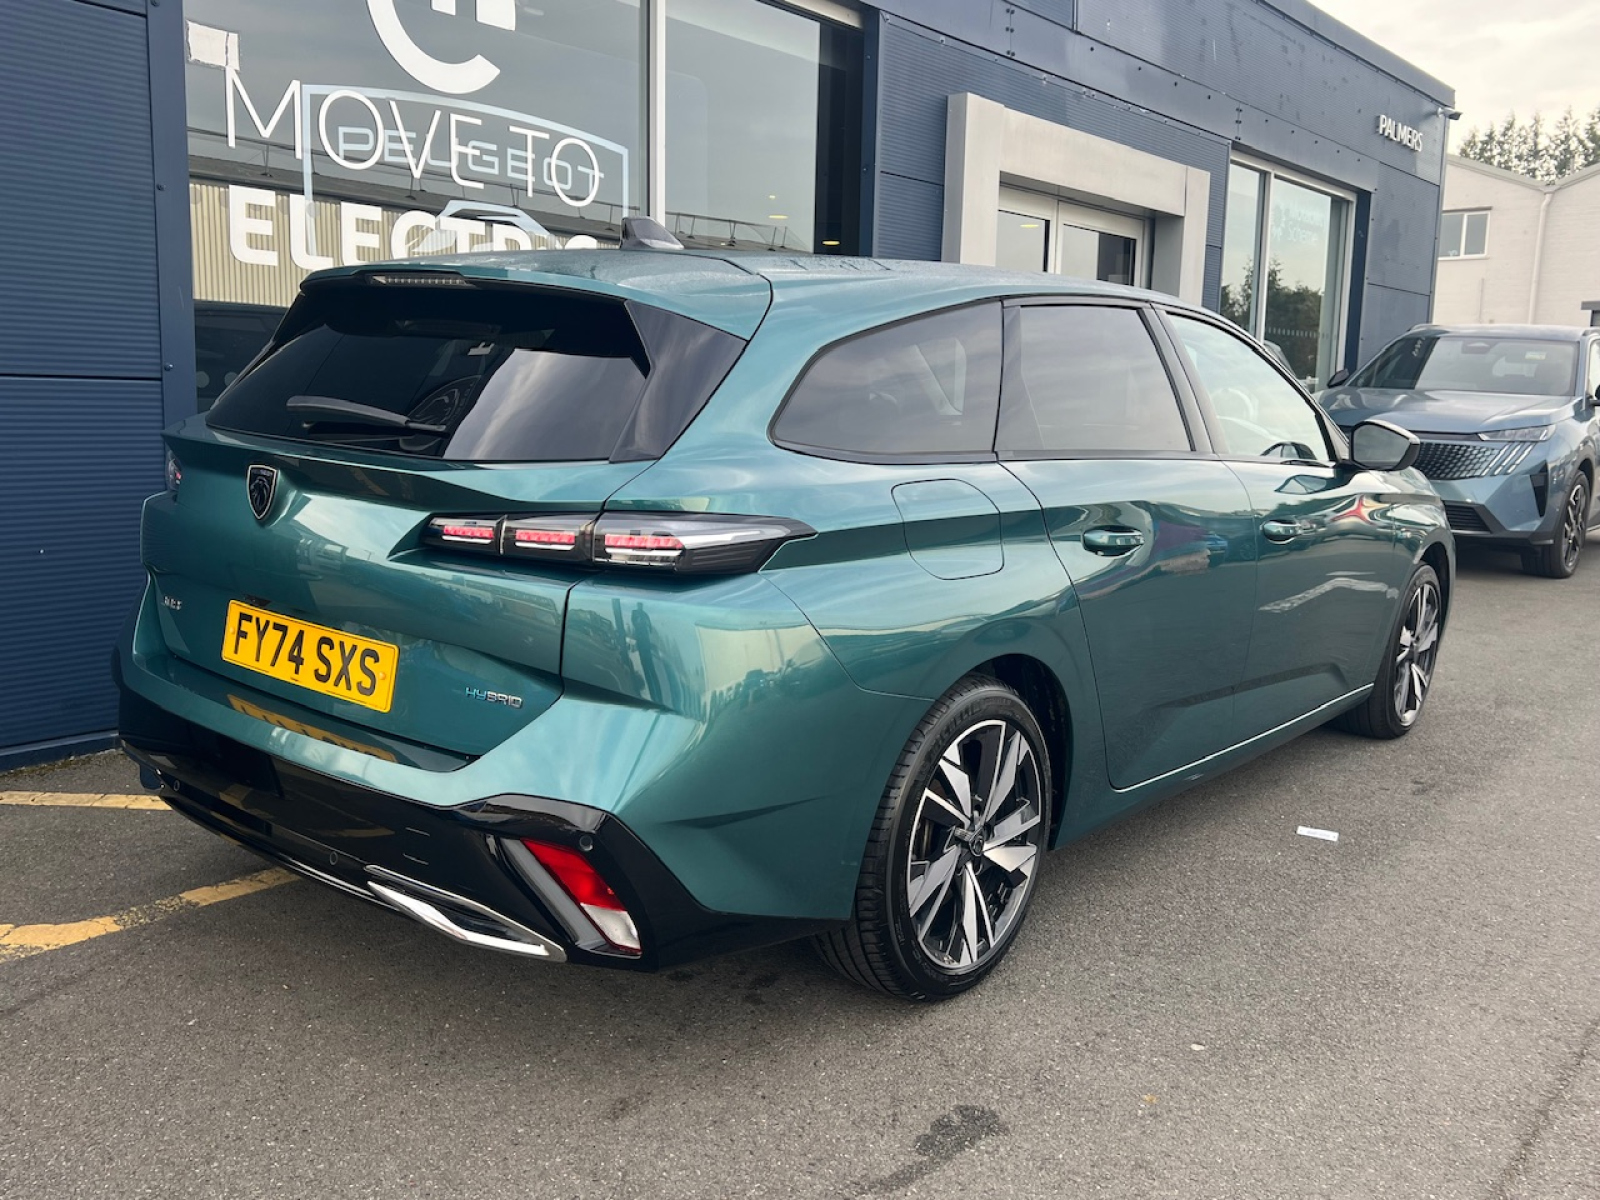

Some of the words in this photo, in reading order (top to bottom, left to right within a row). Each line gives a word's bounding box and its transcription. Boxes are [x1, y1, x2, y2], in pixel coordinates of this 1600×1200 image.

[225, 68, 484, 189] MOVE
[509, 125, 601, 208] TO
[338, 126, 605, 194] PEUGEOT
[1379, 114, 1423, 152] PALMERS
[233, 612, 305, 675] FY74
[314, 636, 380, 696] SXS
[465, 686, 523, 708] HYBRID
